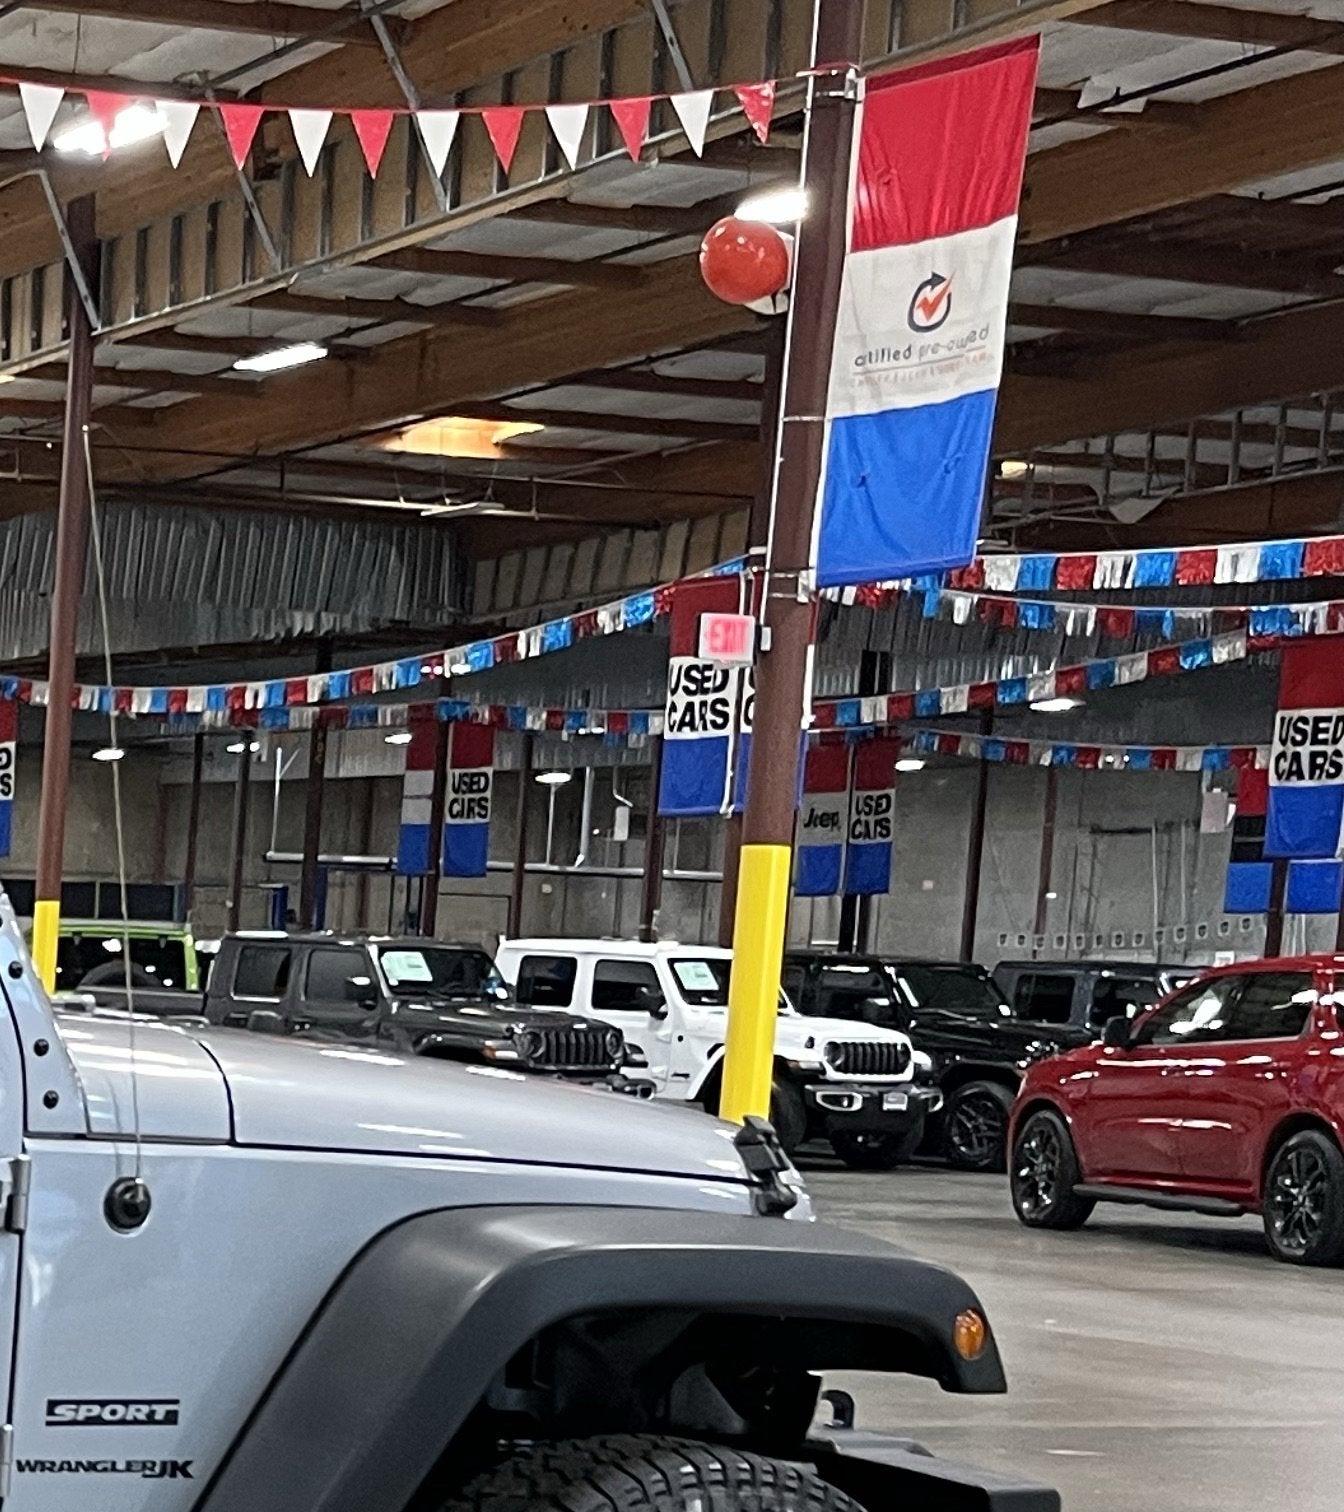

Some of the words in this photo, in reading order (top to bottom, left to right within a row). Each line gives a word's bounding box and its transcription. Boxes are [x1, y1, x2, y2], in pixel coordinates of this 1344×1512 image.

[707, 619, 747, 653] EXIT
[669, 663, 730, 697] USED
[667, 697, 730, 733] CARS
[1274, 748, 1344, 781] CARS
[452, 771, 490, 795] USED
[49, 1402, 180, 1424] SPORT
